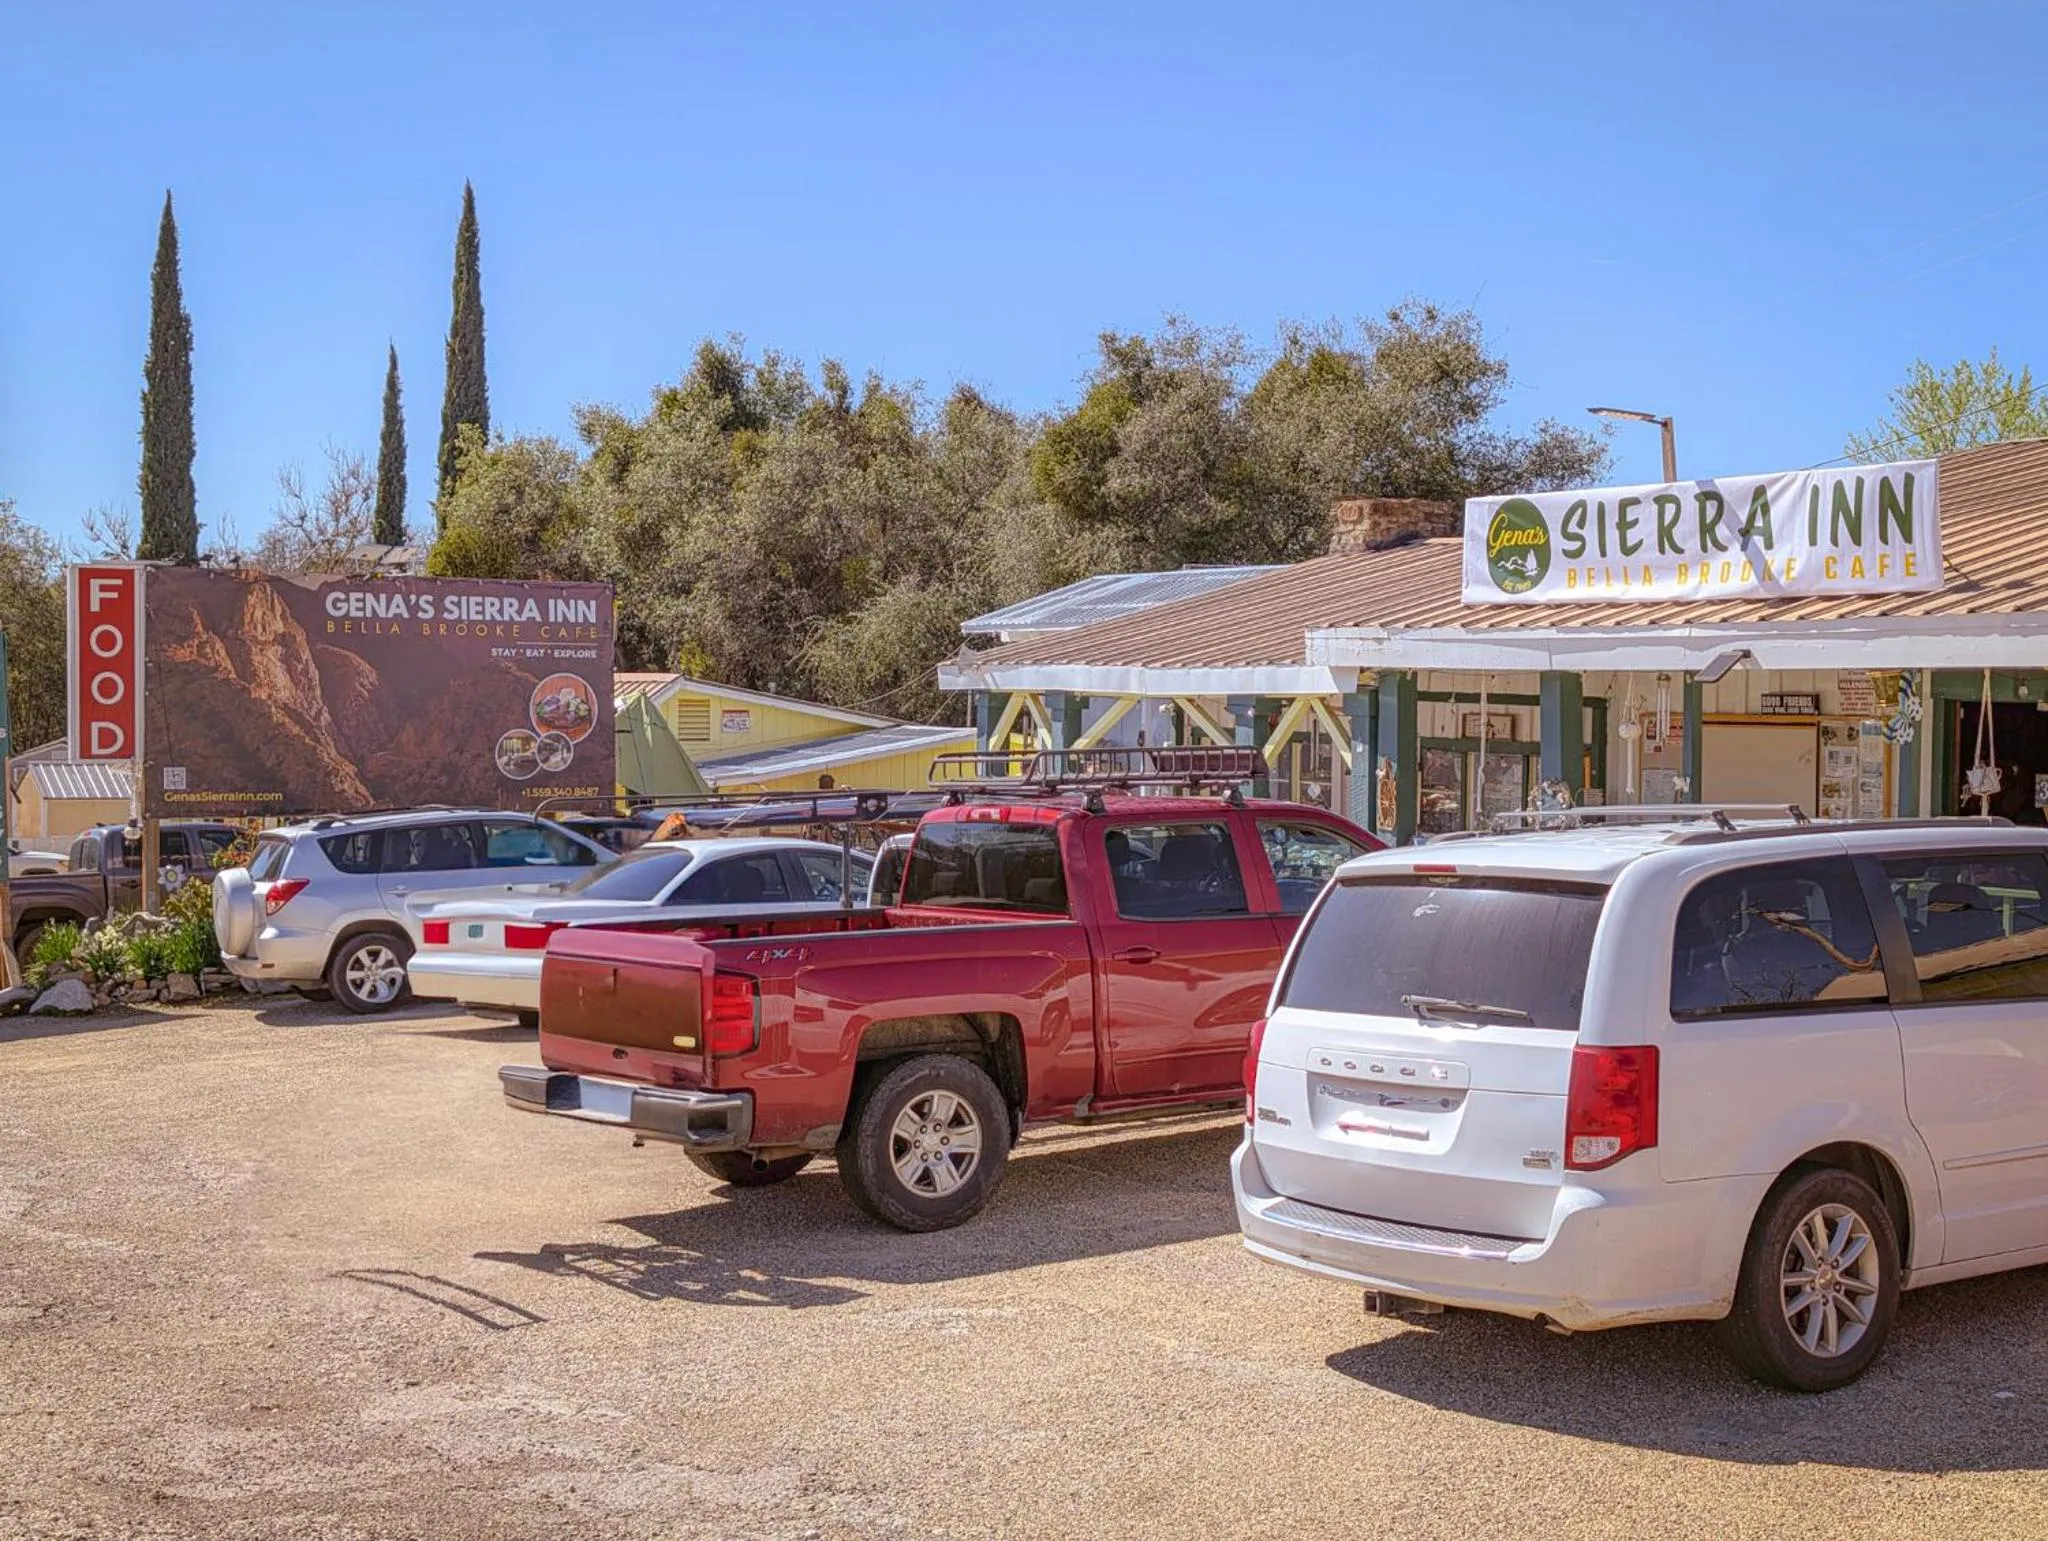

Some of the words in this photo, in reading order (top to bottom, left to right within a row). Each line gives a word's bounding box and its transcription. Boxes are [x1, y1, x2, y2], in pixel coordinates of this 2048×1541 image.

[1488, 508, 1549, 558] Gena's
[1560, 484, 1775, 560] SIERRA
[1808, 472, 1916, 548] INN
[1566, 563, 1655, 590] BELLA
[1676, 557, 1798, 586] BROOKE
[1824, 551, 1919, 580] CAFE
[443, 595, 542, 623] SIERRA
[549, 598, 598, 624] INN
[326, 620, 401, 635] BELLA
[422, 622, 521, 638] BROOKE
[540, 624, 599, 639] CAFE
[89, 577, 125, 756] FOOD
[491, 647, 517, 657] STAY
[526, 648, 545, 658] EAT
[553, 649, 598, 659] EXPLORE
[163, 791, 283, 802] GenasSierraInn.com
